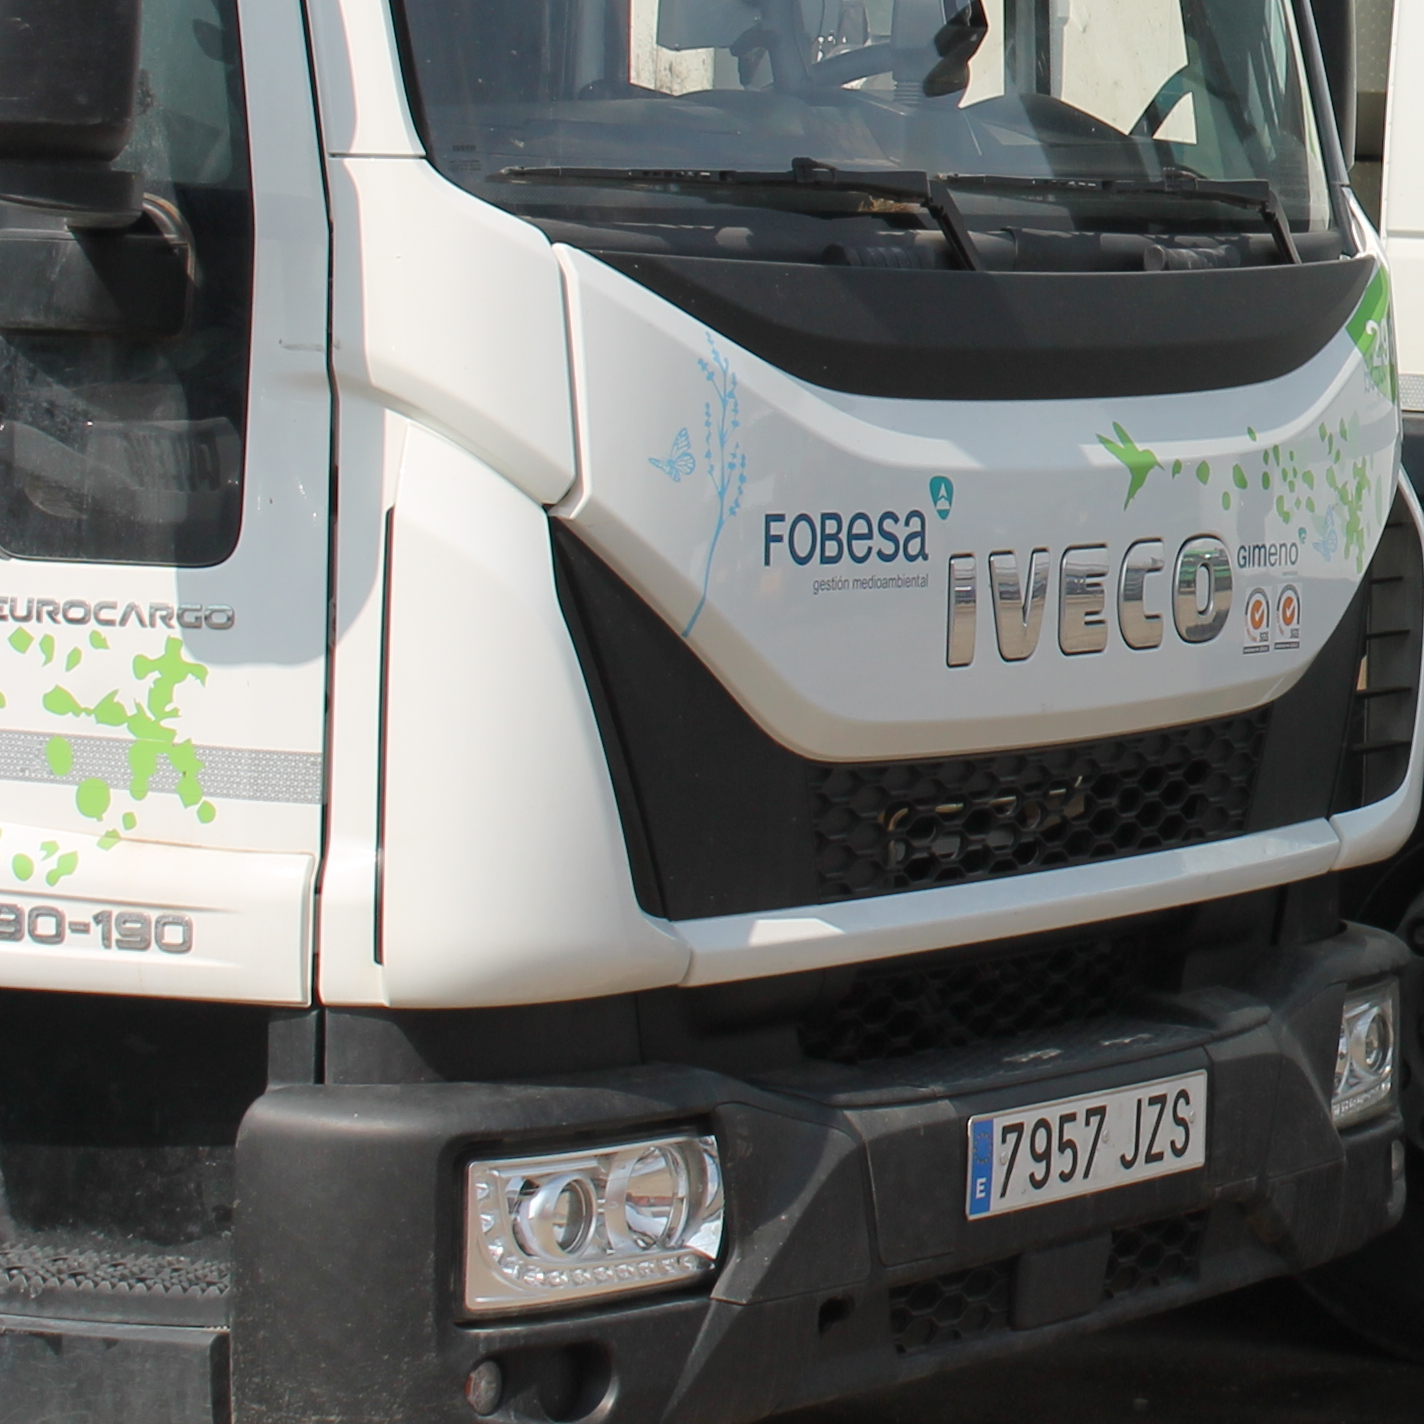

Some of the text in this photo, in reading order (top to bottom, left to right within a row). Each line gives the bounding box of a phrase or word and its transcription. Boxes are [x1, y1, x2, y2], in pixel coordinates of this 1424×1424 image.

[813, 573, 929, 595] gestión medioambiental
[946, 533, 1233, 668] IVECO
[1000, 1088, 1191, 1199] 7957 JZS
[975, 1177, 987, 1199] E
